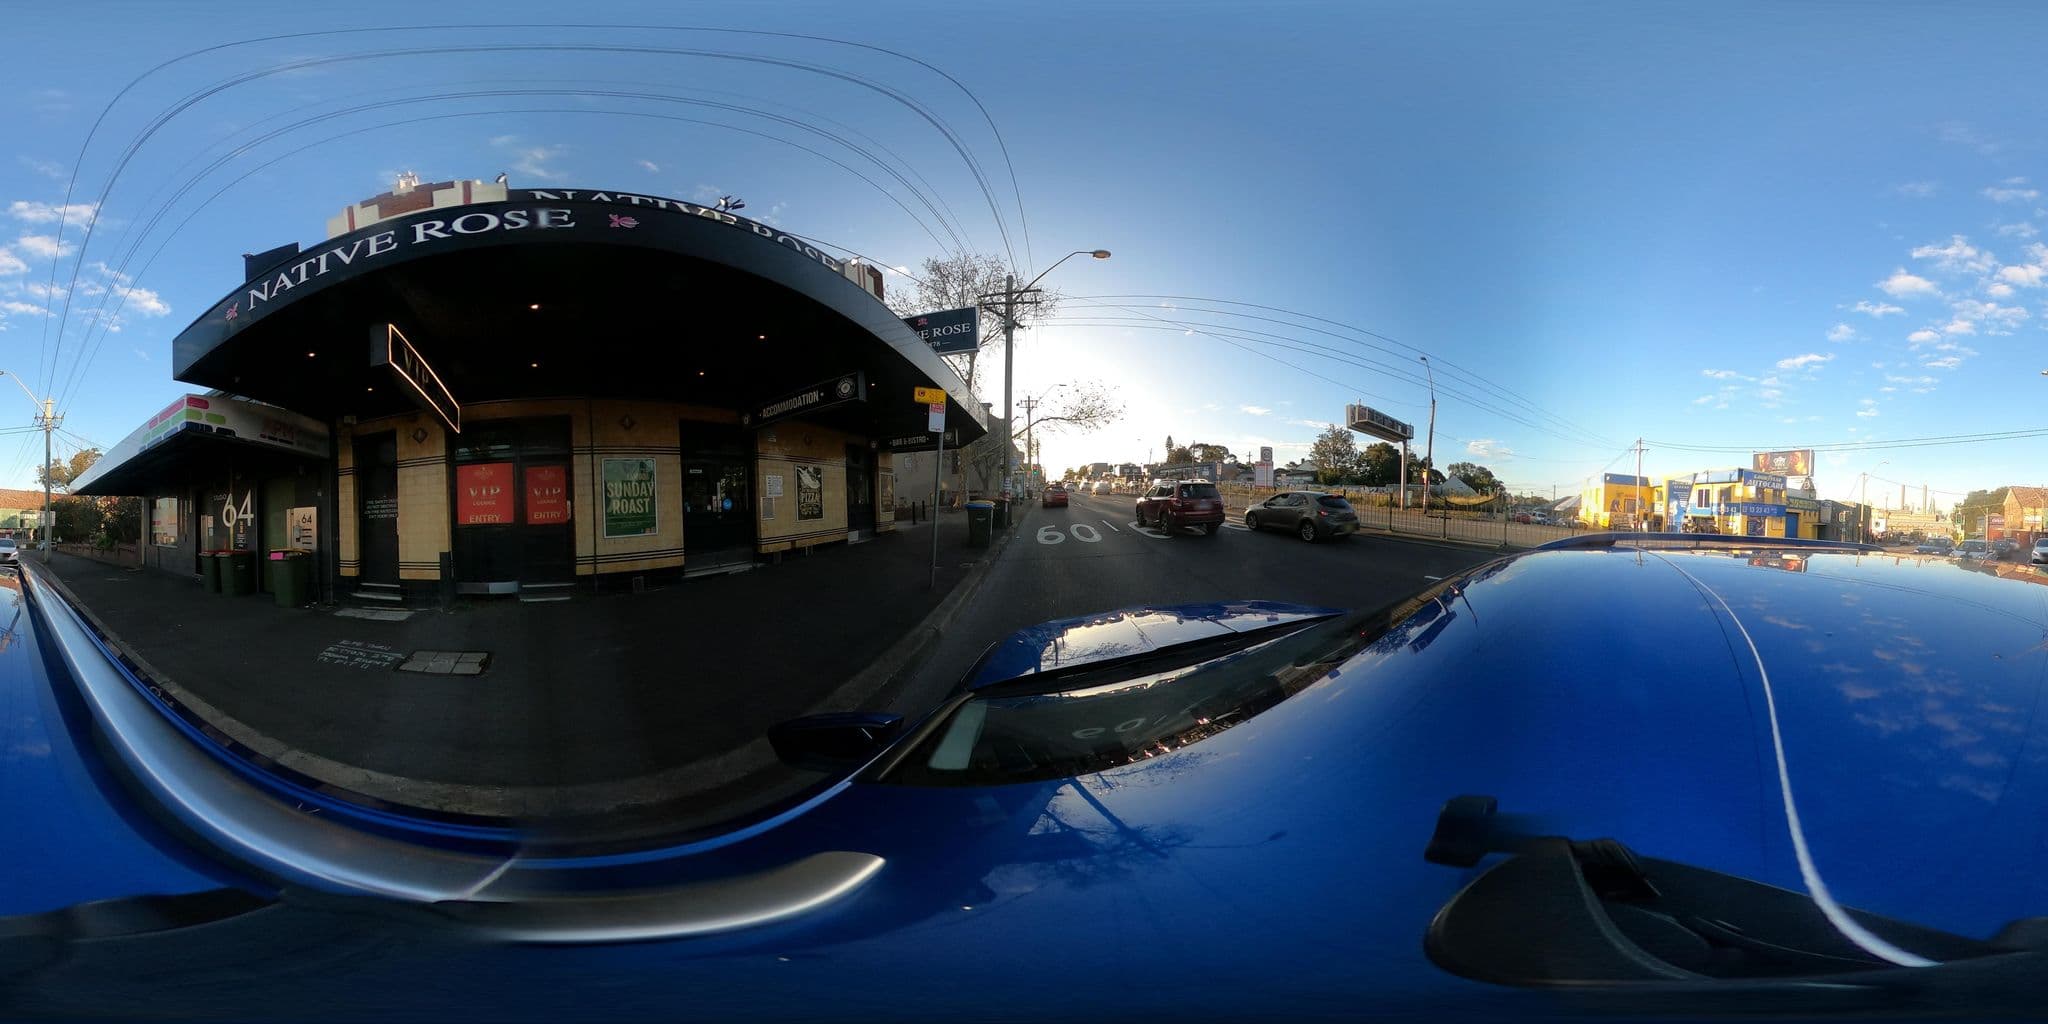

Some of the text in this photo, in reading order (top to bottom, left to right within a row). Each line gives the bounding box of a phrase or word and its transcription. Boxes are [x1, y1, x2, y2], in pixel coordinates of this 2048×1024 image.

[247, 208, 576, 311] NATIVE ROSE
[932, 322, 971, 338] ROSE
[762, 390, 819, 418] ACCOMMODATION
[469, 487, 501, 497] VIP
[533, 487, 561, 497] VIP
[606, 480, 655, 498] SUNDAY
[1746, 479, 1784, 489] AUTOCARE
[222, 489, 254, 527] 64
[613, 497, 650, 514] ROAST
[301, 513, 312, 524] 64
[469, 513, 502, 523] ENTRY
[533, 511, 562, 519] ENTRY
[1036, 523, 1103, 545] 60
